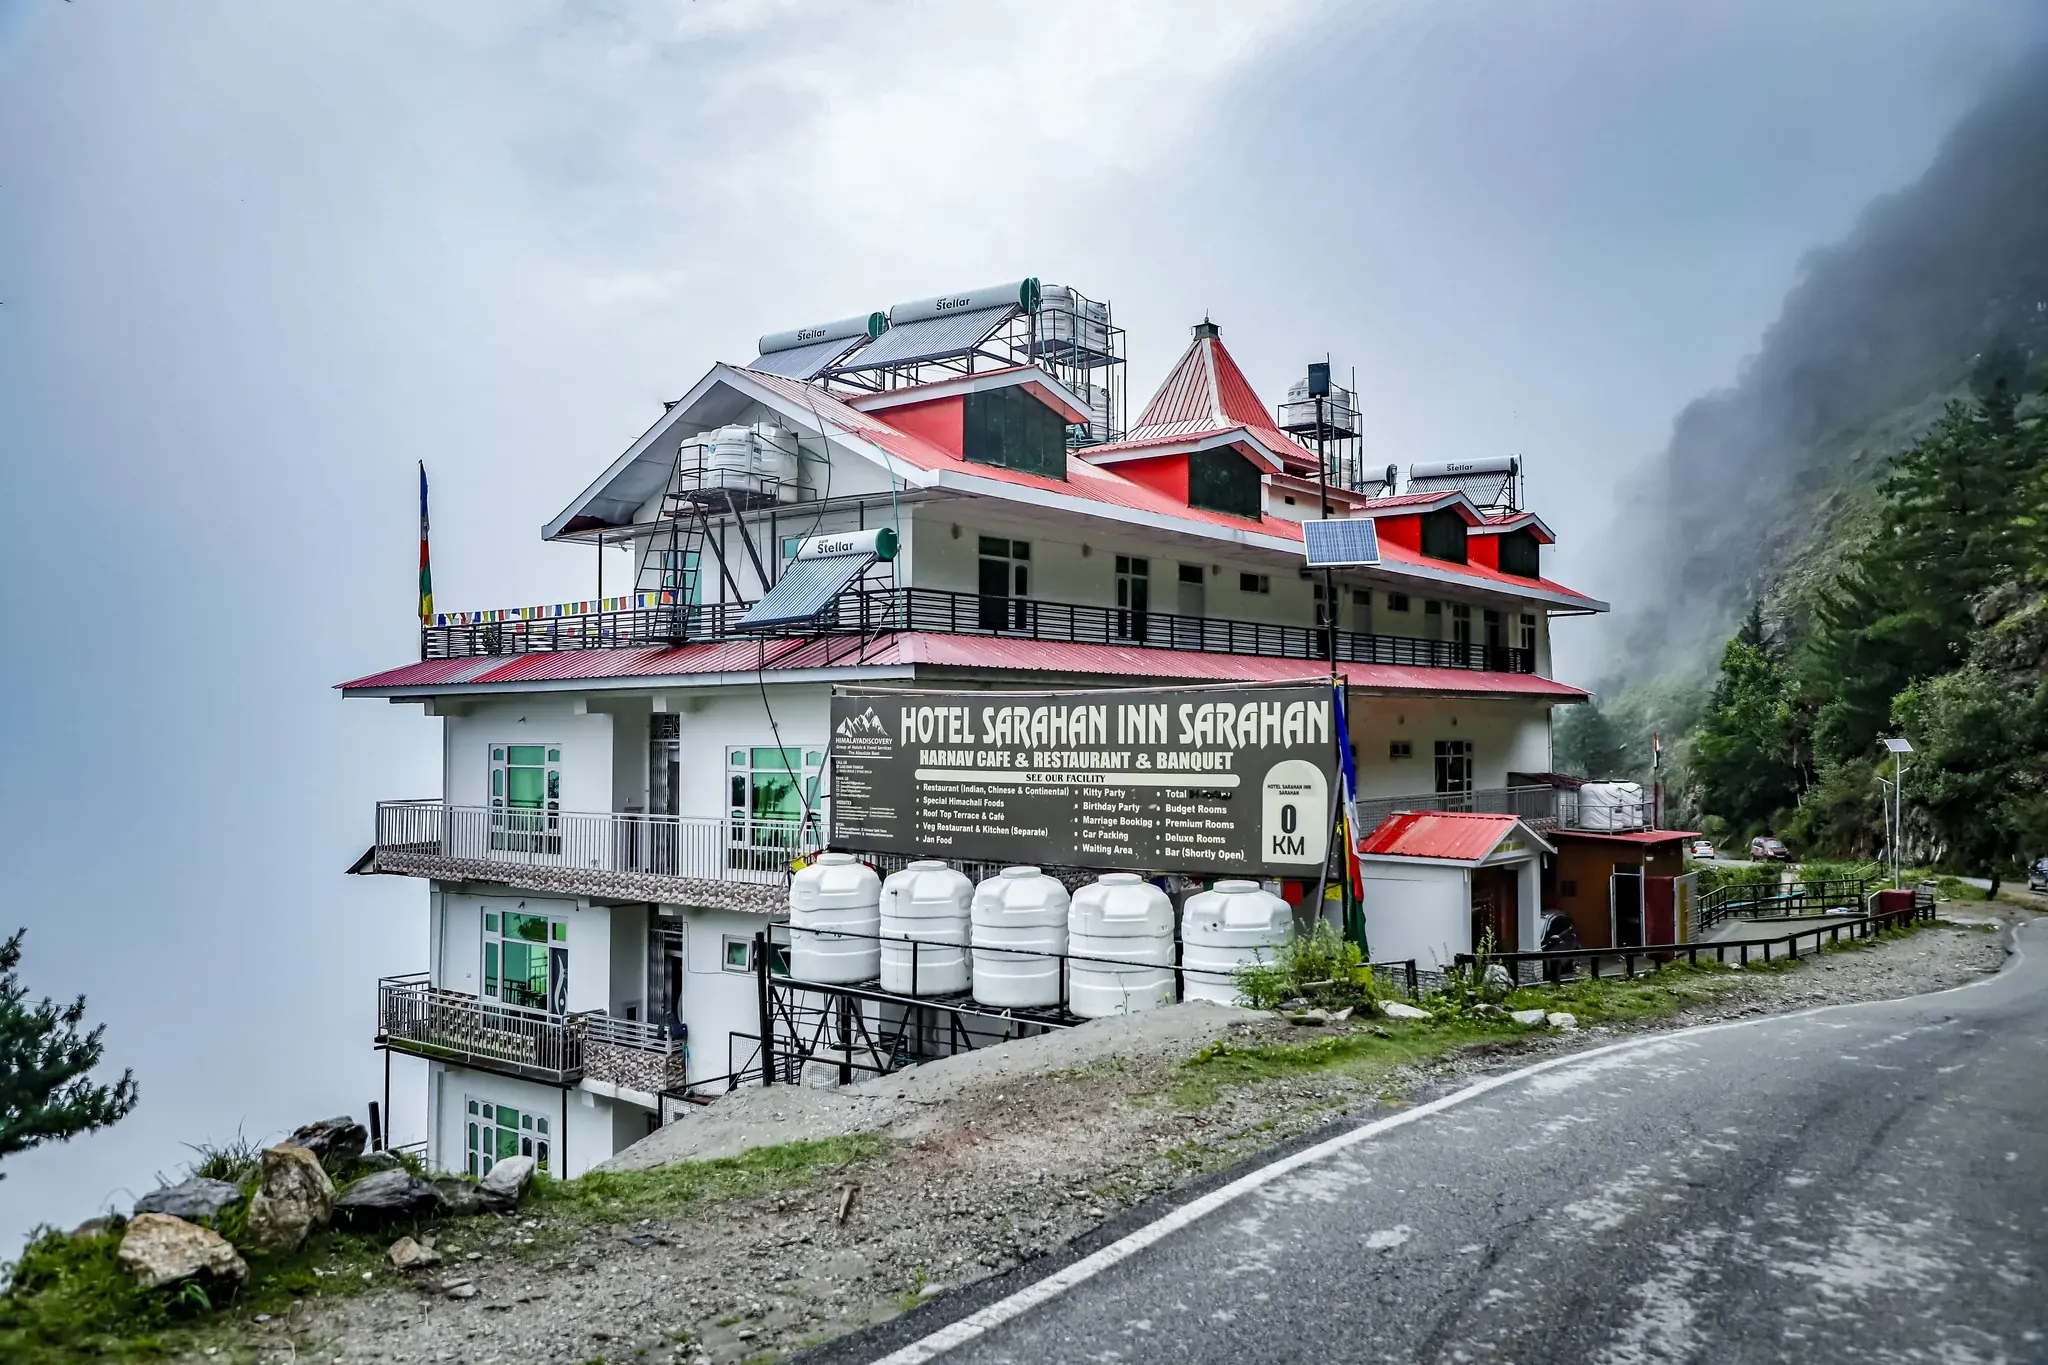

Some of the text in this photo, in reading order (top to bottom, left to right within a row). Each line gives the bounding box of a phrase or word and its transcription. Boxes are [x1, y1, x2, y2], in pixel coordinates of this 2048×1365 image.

[936, 298, 970, 310] Stellar
[797, 329, 826, 341] Stellar
[817, 541, 854, 554] Stellar
[901, 701, 1329, 749] HOTEL SARAHAN INN SARAHAN
[835, 737, 893, 745] HIMALAYADISCOVERY
[919, 750, 1234, 771] HARNAV CAFE & RESTAURANT & BANQUET
[1026, 773, 1106, 783] SEE OUR FACILITY
[923, 783, 1070, 796] Restaurant (Indian, Chinese & Continental)
[1083, 788, 1126, 799] Kitty Party
[1165, 789, 1187, 798] Total
[922, 796, 1005, 808] Special Himachali Foods
[1083, 801, 1140, 813] Birthday Party
[922, 808, 1005, 821] Roof Top Terrace & Café
[1165, 804, 1227, 815] Budget Rooms
[1082, 815, 1153, 828] Marriage Booking
[1165, 818, 1235, 829] Premium Rooms
[1281, 804, 1296, 834] 0
[922, 822, 1048, 837] Veg Restaurant & Kitchen (Separate)
[1082, 829, 1129, 841] Car Parking
[922, 835, 953, 845] Jan Food
[1165, 833, 1226, 844] Deluxe Rooms
[1082, 844, 1133, 855] Waiting Area
[1272, 835, 1305, 855] KM
[1165, 847, 1245, 861] Bar (Shortly Open)
